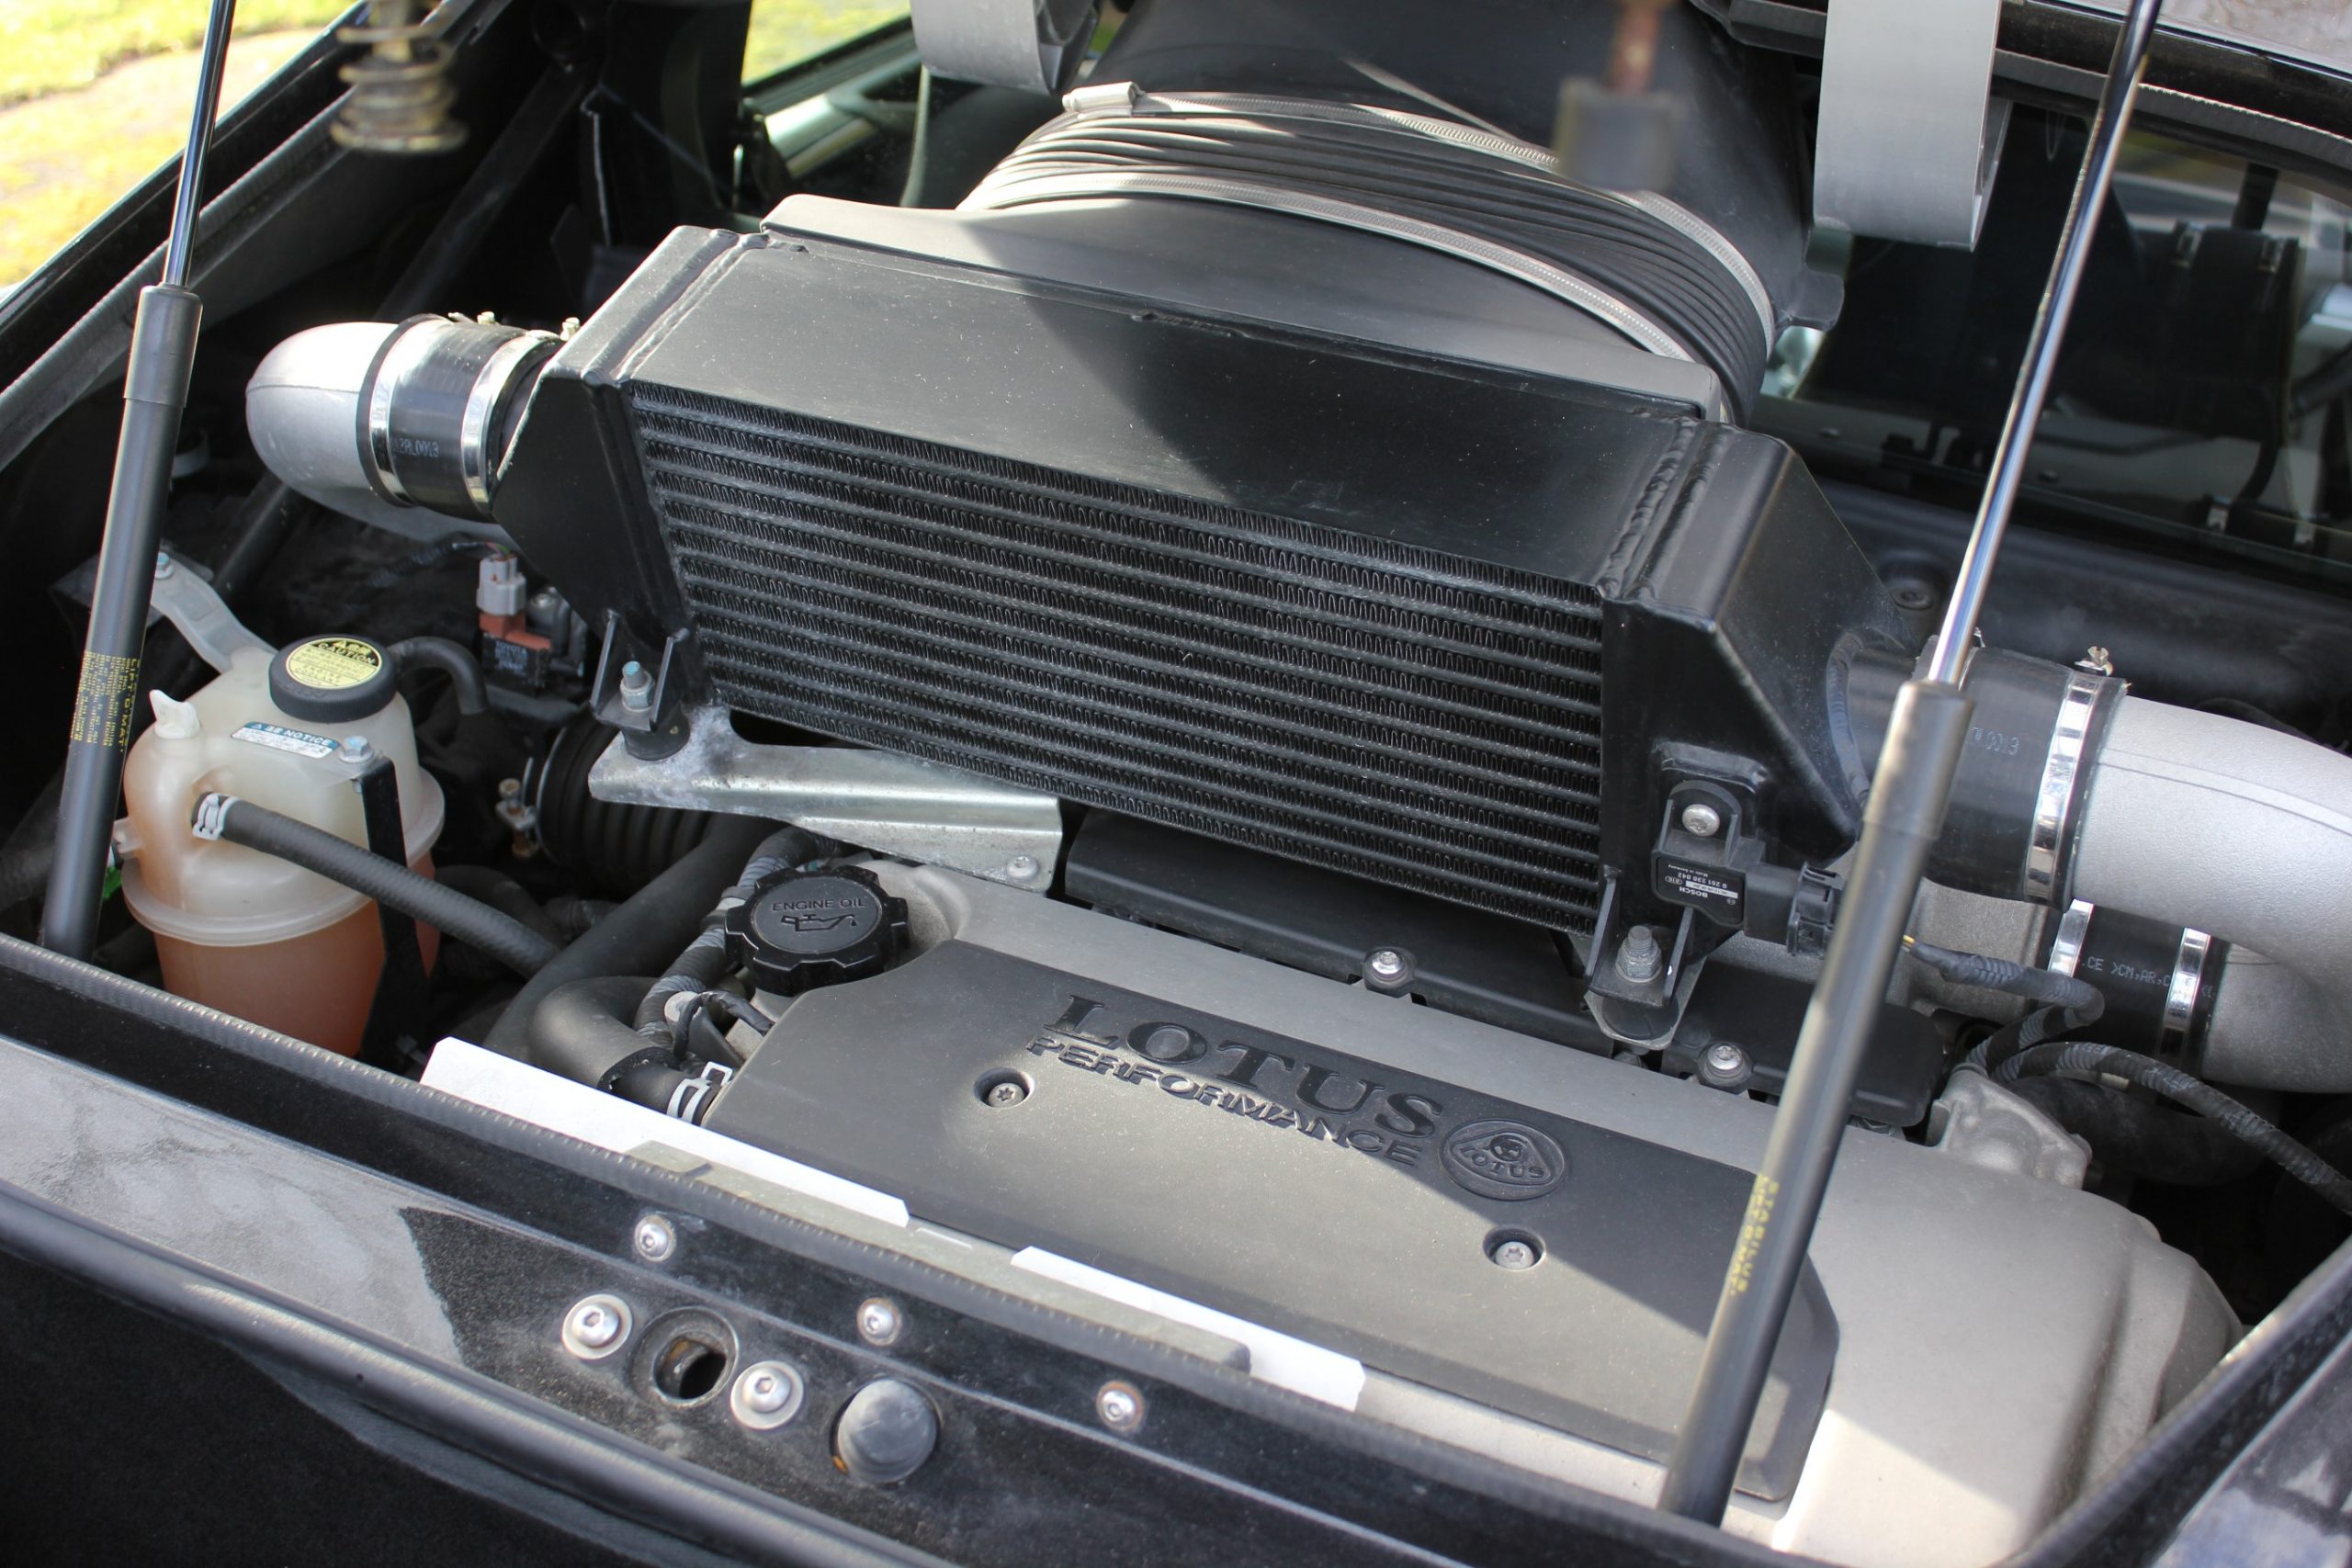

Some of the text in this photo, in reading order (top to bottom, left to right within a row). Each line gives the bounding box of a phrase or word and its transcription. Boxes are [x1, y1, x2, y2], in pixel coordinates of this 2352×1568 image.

[318, 642, 376, 664] CAUTION
[285, 728, 334, 747] NOTICE
[1679, 886, 1708, 898] BOSCH
[773, 897, 866, 912] ENGINE OIL
[1042, 994, 1444, 1140] LOTUS
[1025, 1036, 1423, 1167] PERFORMANCE
[1460, 1146, 1545, 1179] LOTUS
